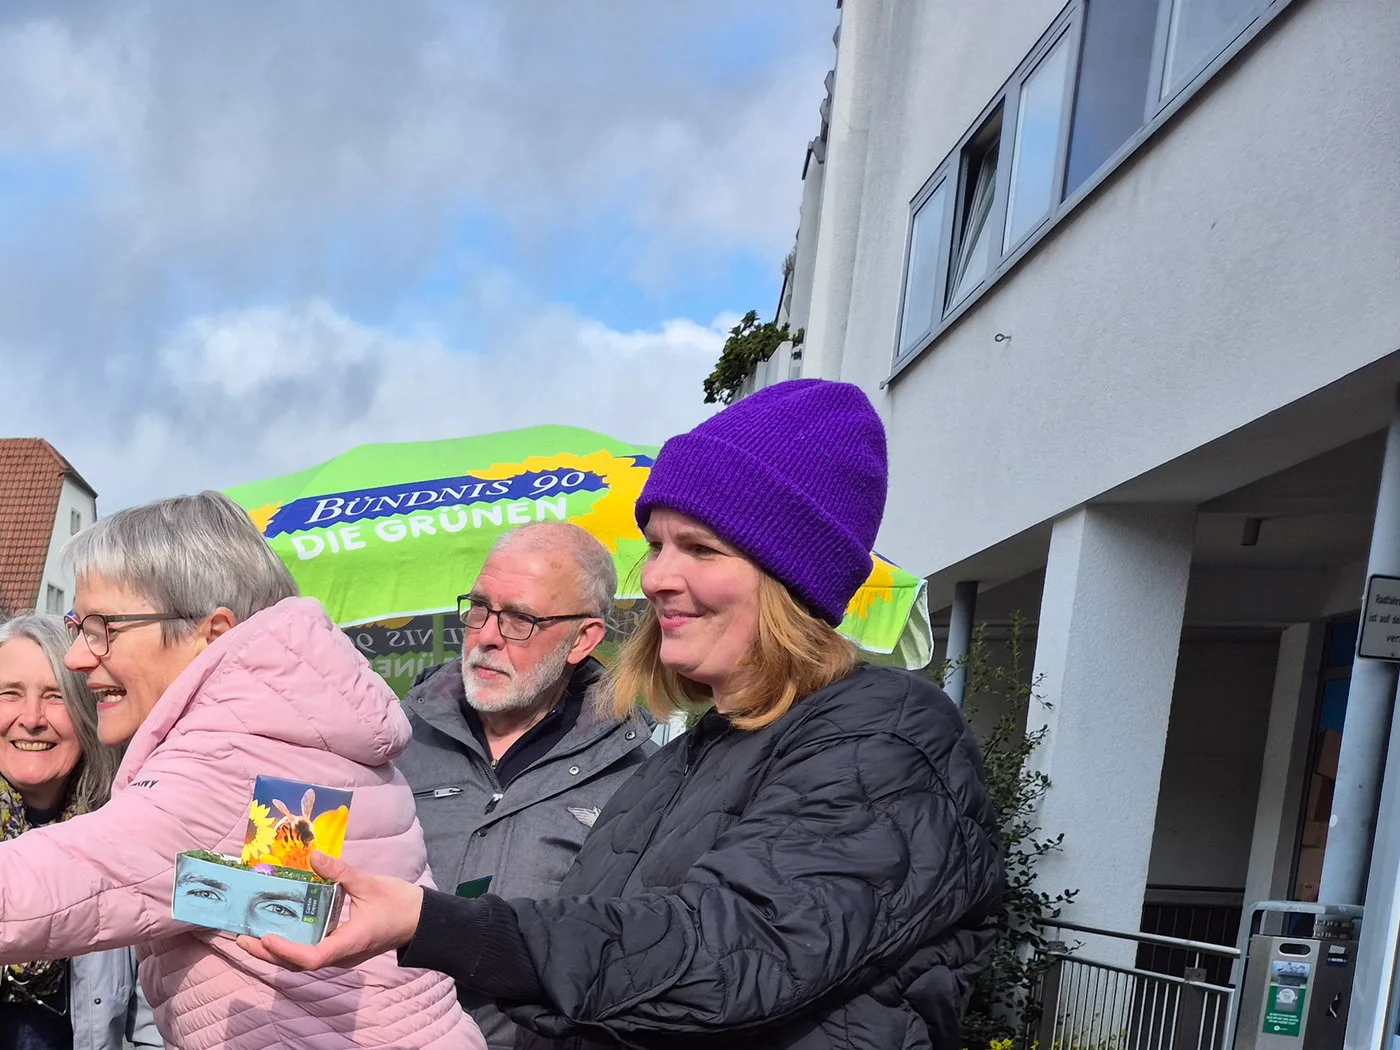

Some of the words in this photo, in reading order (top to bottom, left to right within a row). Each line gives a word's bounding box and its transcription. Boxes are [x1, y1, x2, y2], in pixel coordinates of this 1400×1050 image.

[305, 478, 512, 525] BÜNDNIS
[531, 472, 586, 495] 90
[290, 525, 366, 561] DIE
[376, 498, 567, 546] GRÜNEN
